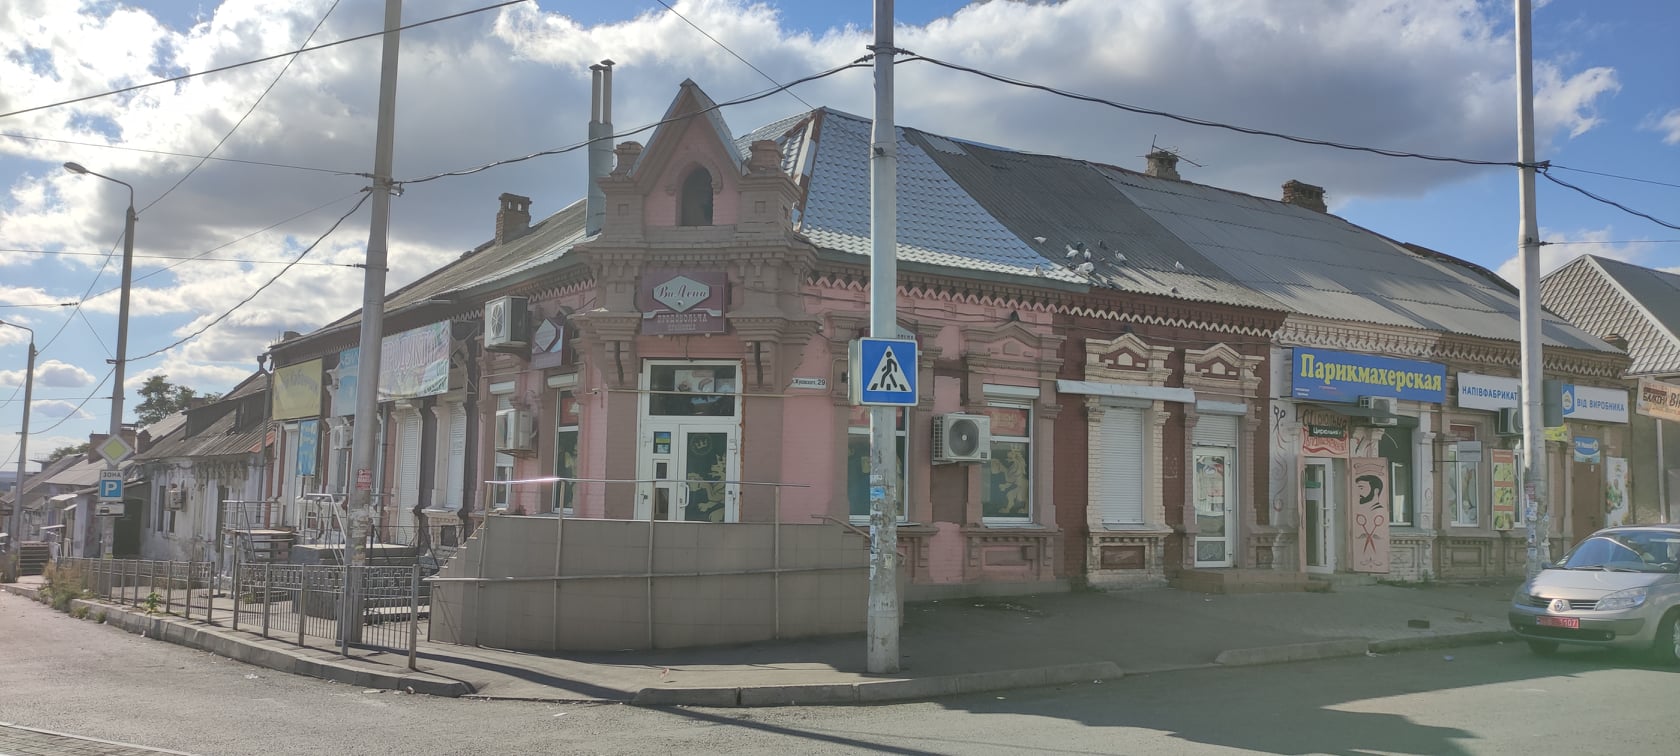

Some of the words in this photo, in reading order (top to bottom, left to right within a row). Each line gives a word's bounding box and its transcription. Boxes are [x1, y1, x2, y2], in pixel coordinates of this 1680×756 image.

[1301, 353, 1441, 392] Парикмахерская
[1577, 398, 1587, 408] ВІД
[1589, 399, 1625, 412] ВИРОБНИКА
[105, 481, 118, 497] P
